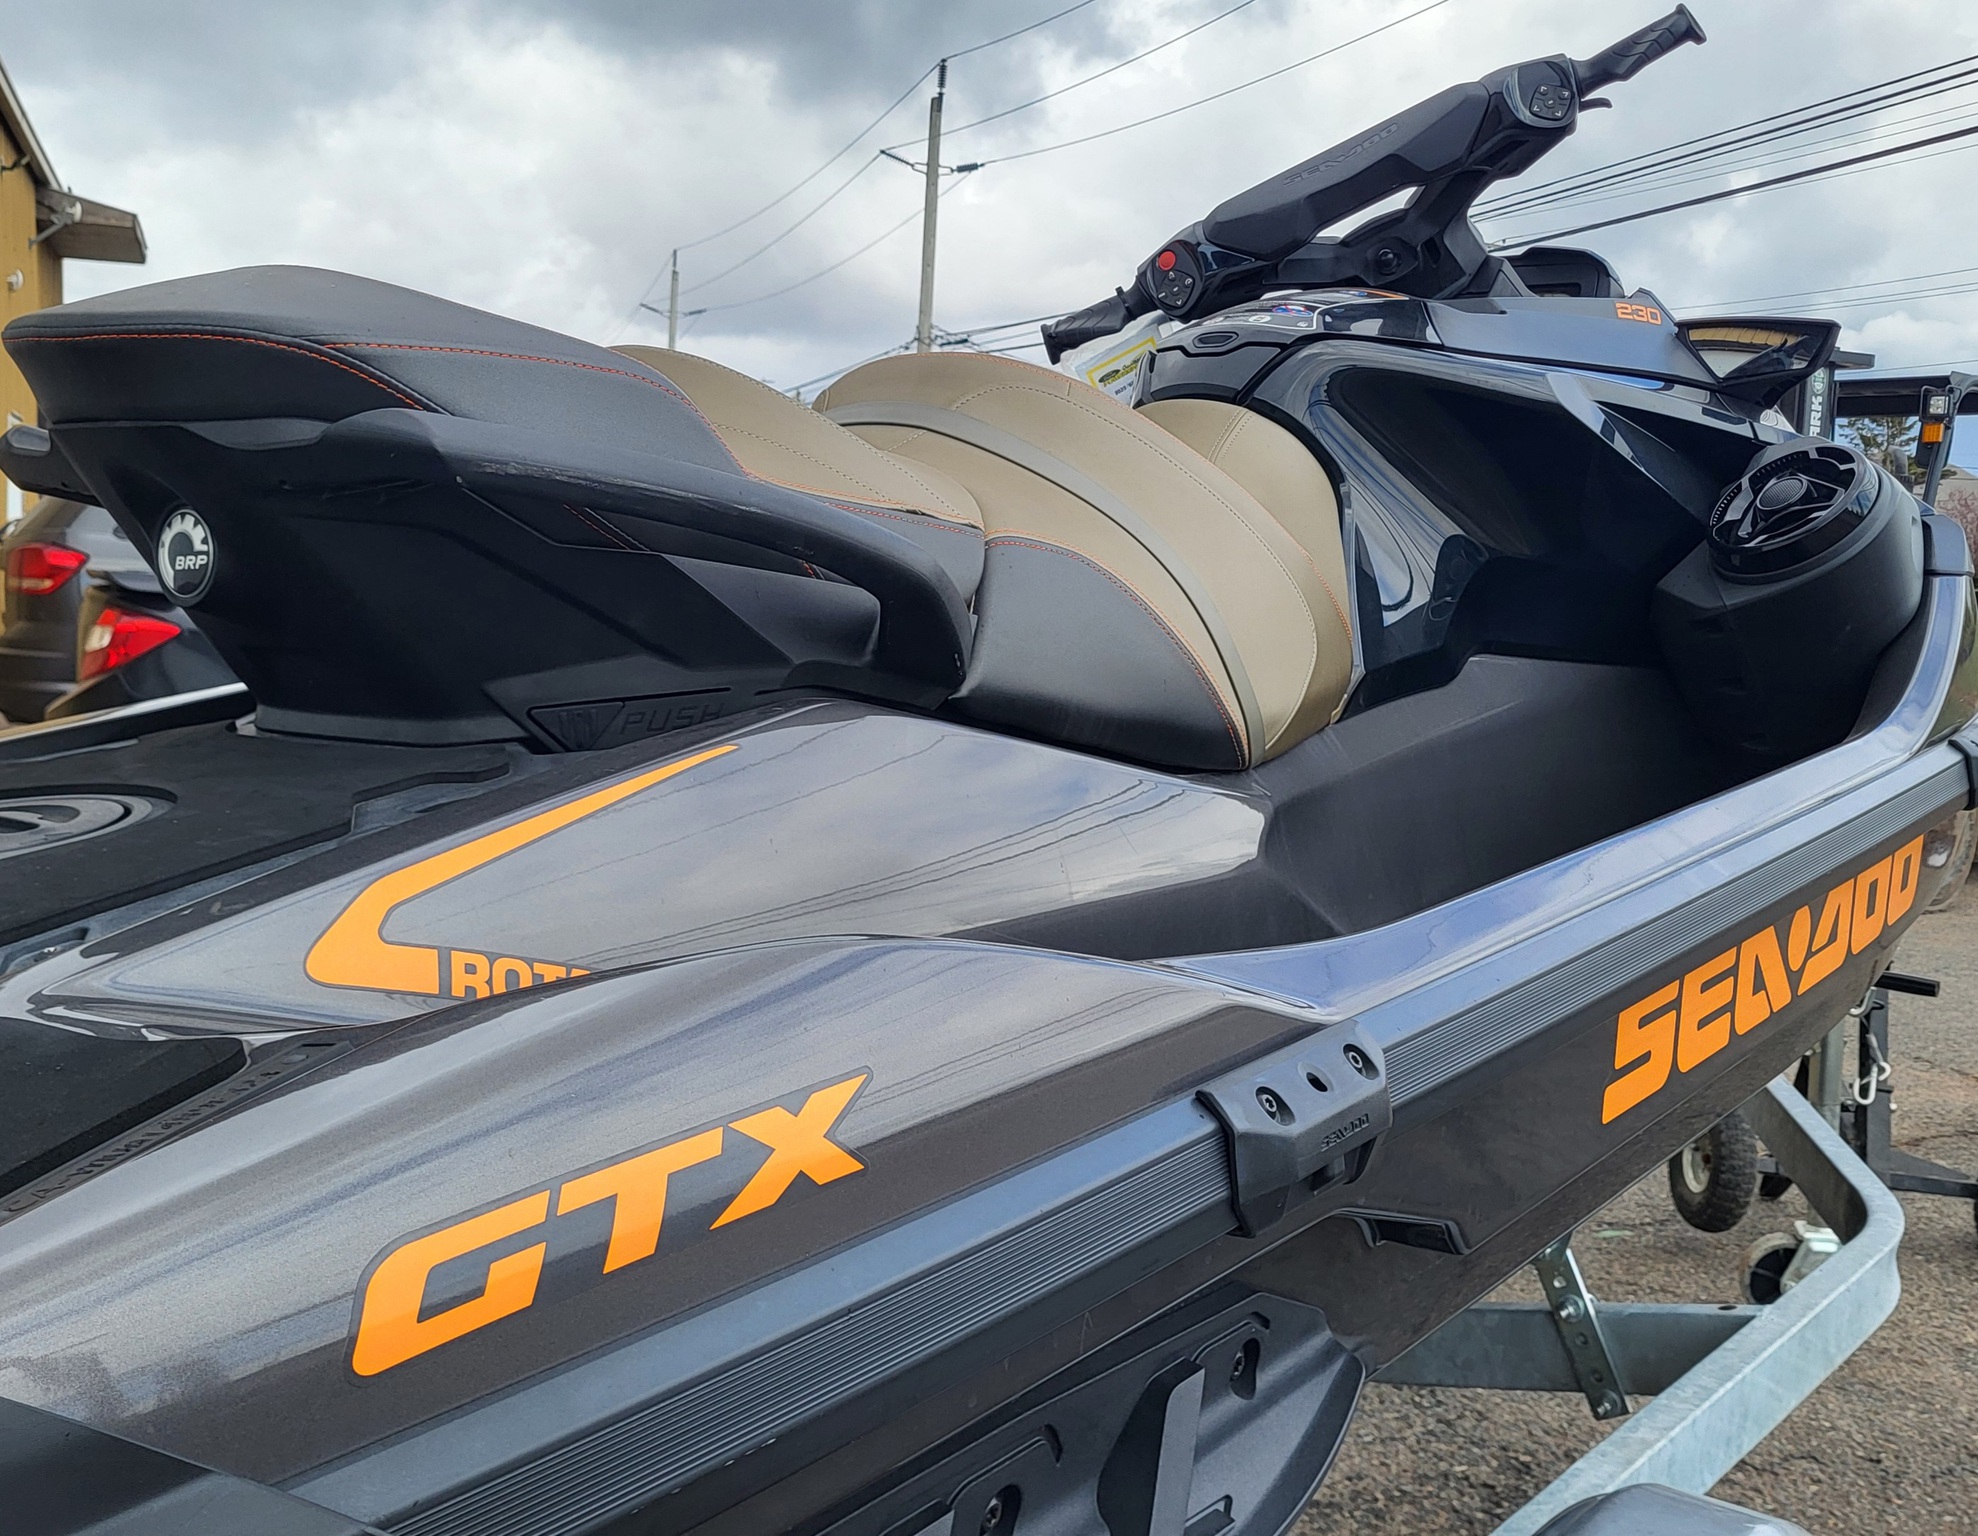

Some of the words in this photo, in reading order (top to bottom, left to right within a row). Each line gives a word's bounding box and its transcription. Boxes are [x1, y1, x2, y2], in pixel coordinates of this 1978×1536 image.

[1615, 302, 1662, 325] 230
[175, 554, 208, 571] BRP
[620, 703, 724, 736] PUSH
[450, 950, 592, 999] ROT
[351, 1073, 869, 1377] GTX
